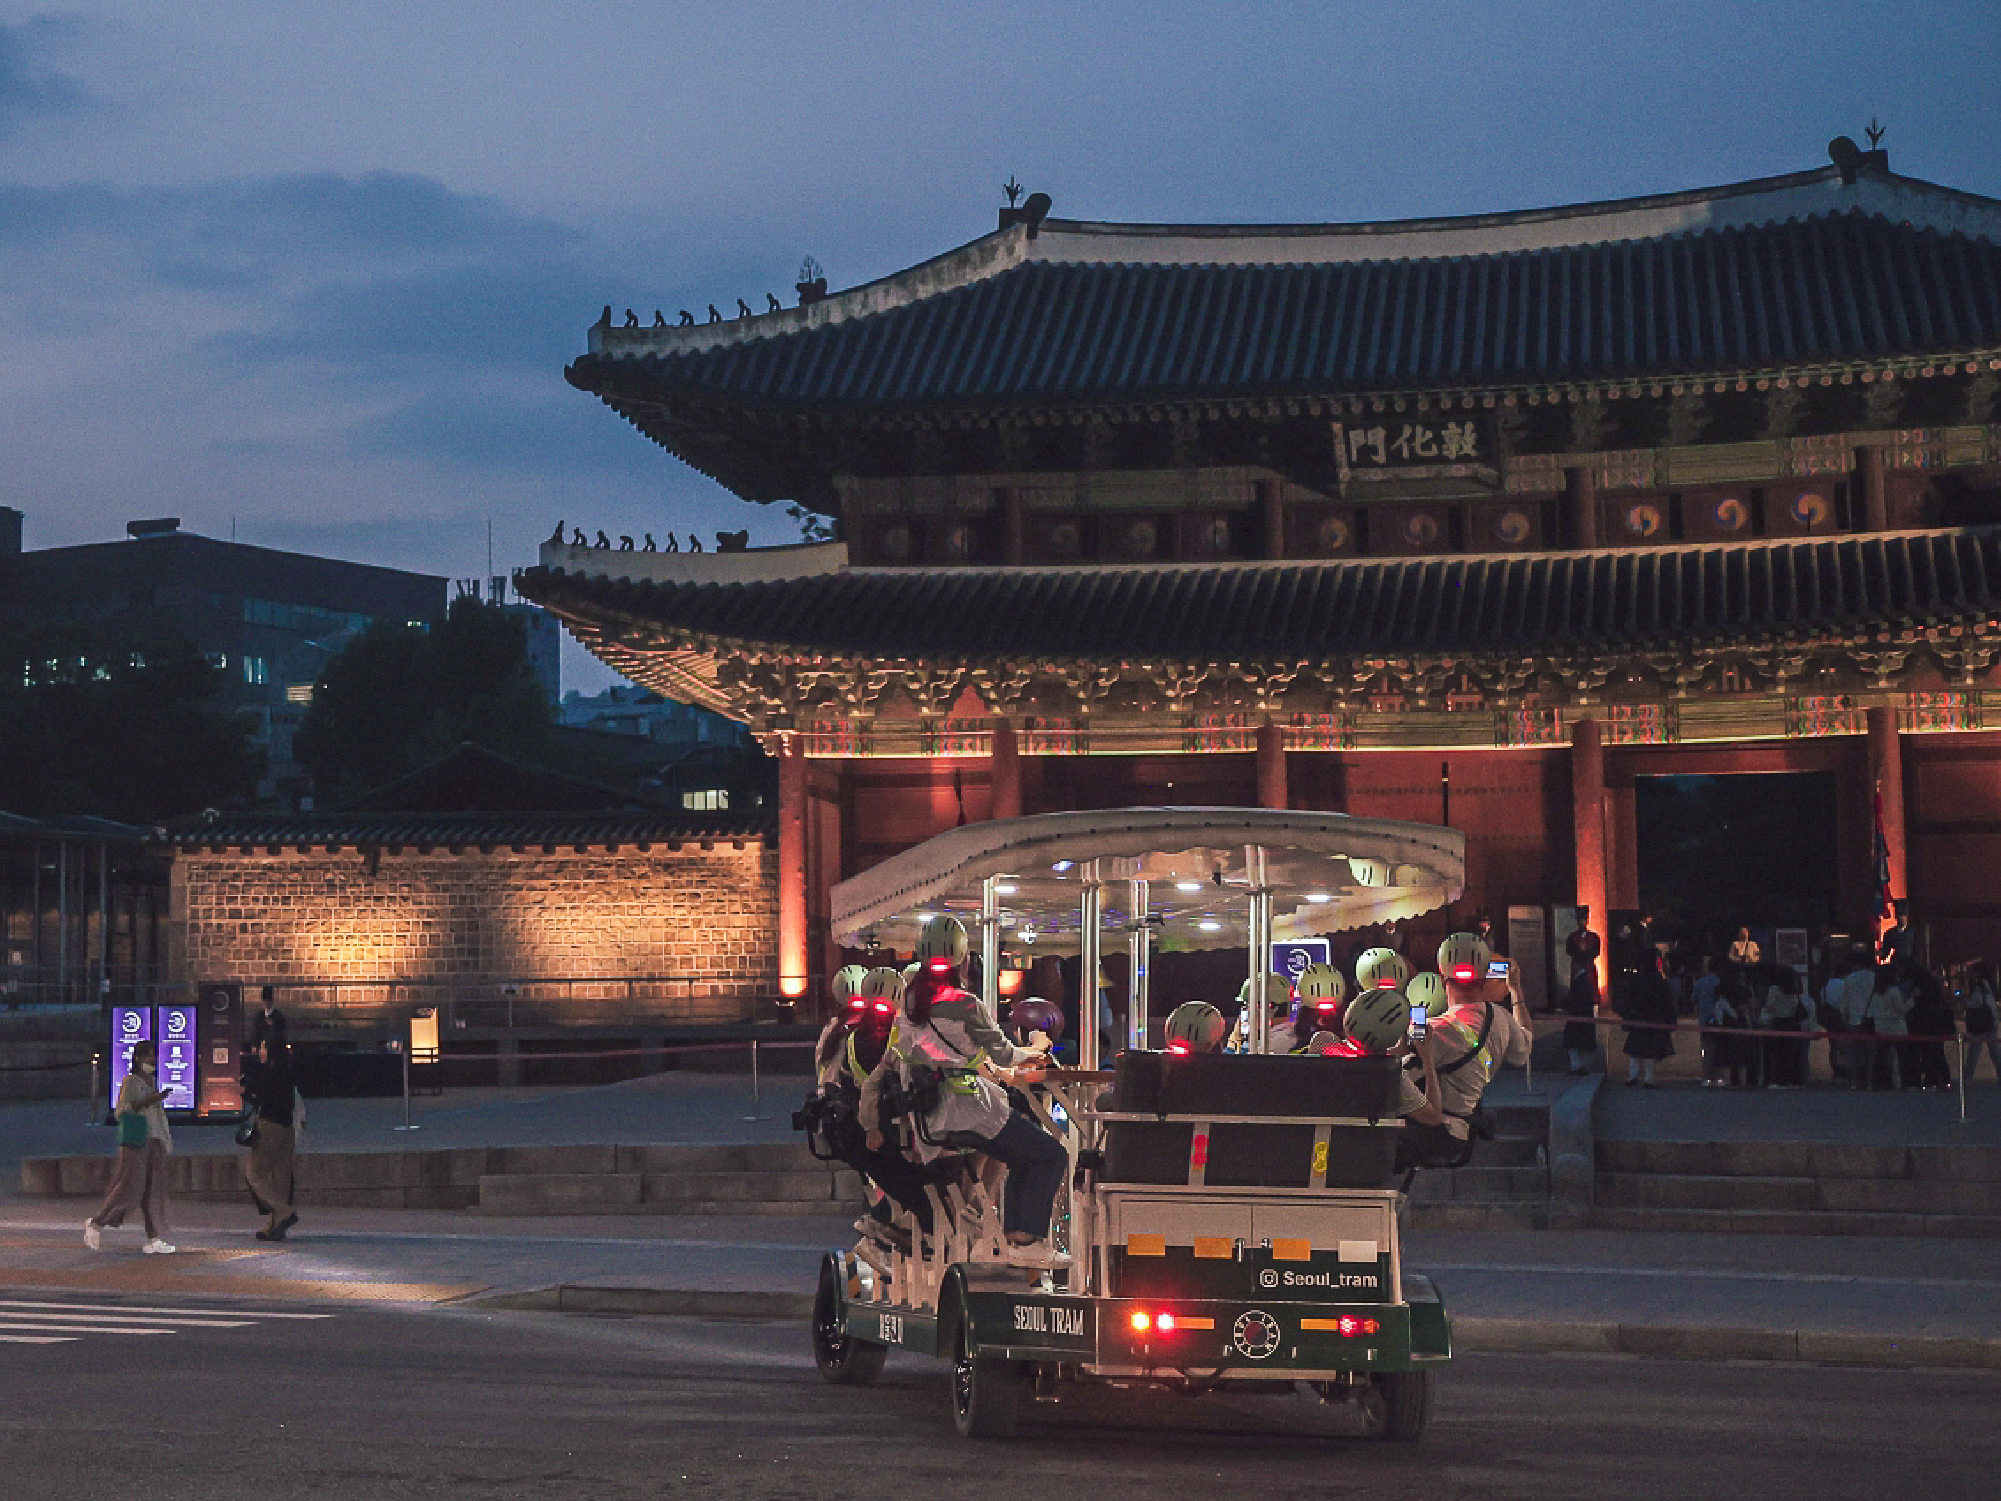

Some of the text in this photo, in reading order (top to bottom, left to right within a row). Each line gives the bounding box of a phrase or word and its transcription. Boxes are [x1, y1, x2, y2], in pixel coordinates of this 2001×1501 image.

[1283, 1270, 1377, 1290] Seoul_tram
[1014, 1304, 1083, 1336] SEOUL TRAM
